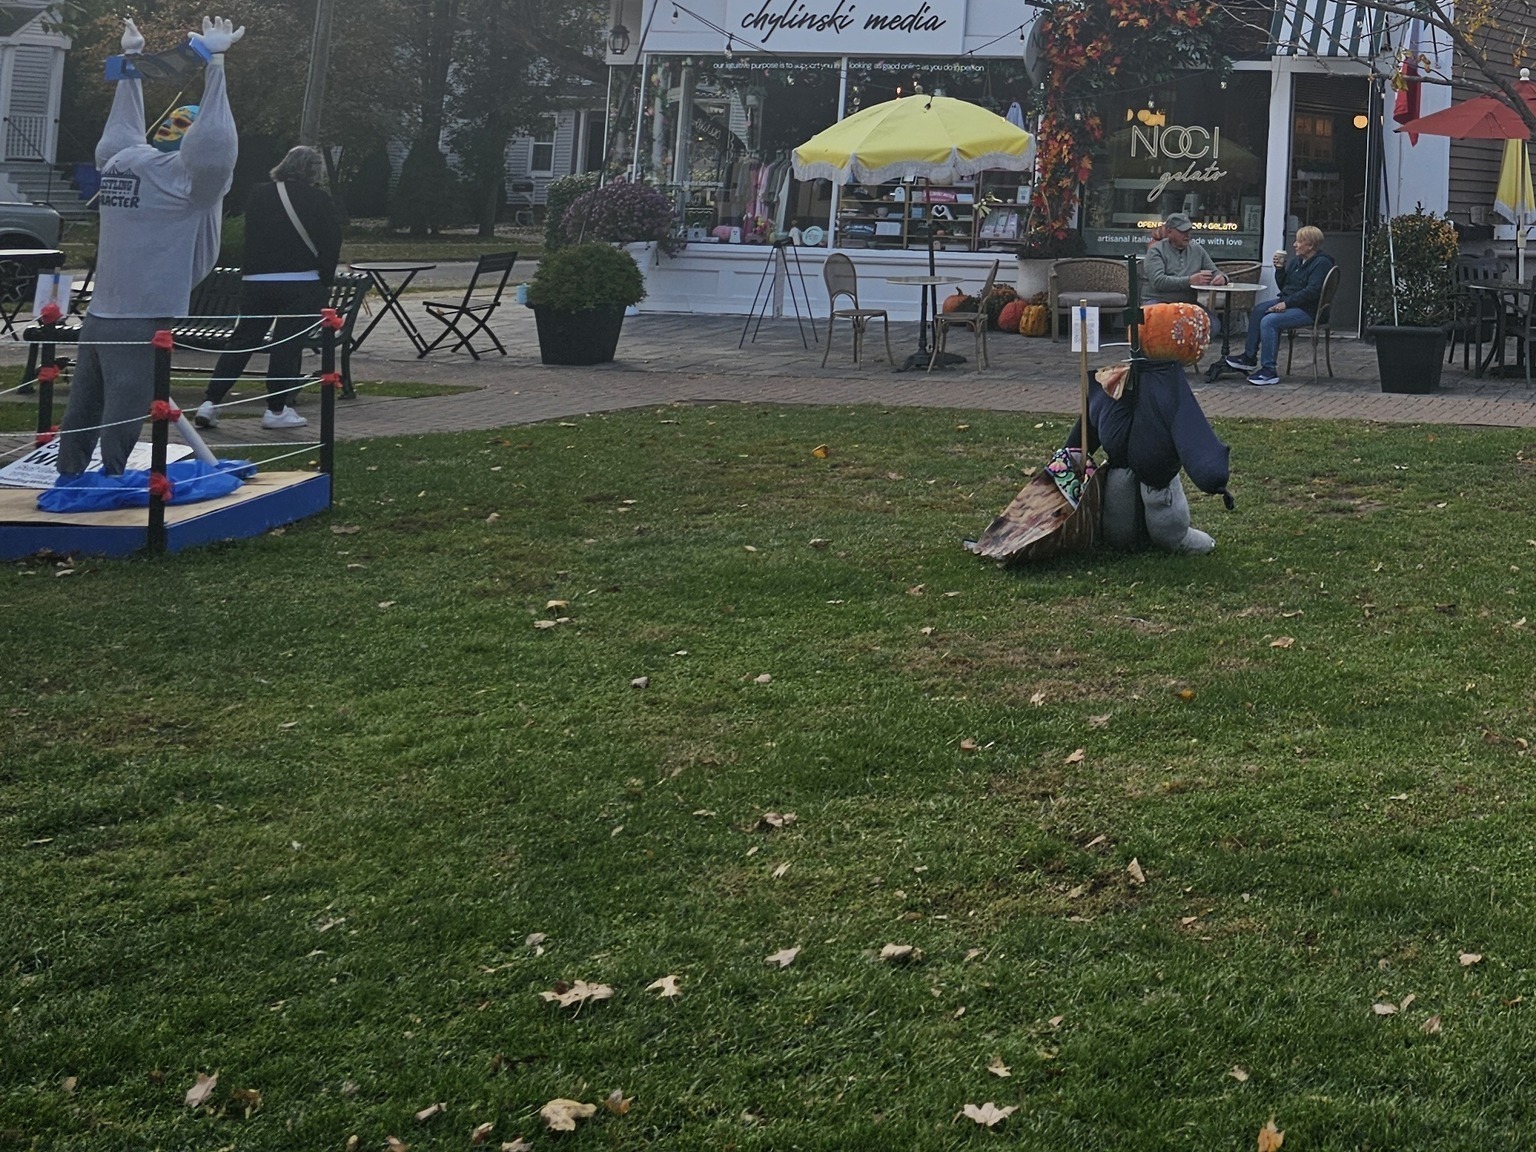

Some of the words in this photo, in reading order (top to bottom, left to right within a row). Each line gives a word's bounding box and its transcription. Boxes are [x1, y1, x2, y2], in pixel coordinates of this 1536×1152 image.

[863, 1, 947, 34] media
[751, 62, 779, 71] purpose
[849, 61, 871, 71] looking
[882, 62, 900, 71] good
[930, 64, 943, 73] you
[1131, 125, 1220, 159] NOCI
[1147, 161, 1228, 203] gelato
[1097, 234, 1130, 243] artisanal
[1190, 237, 1205, 245] ade
[1207, 237, 1224, 245] with
[1226, 237, 1243, 246] love
